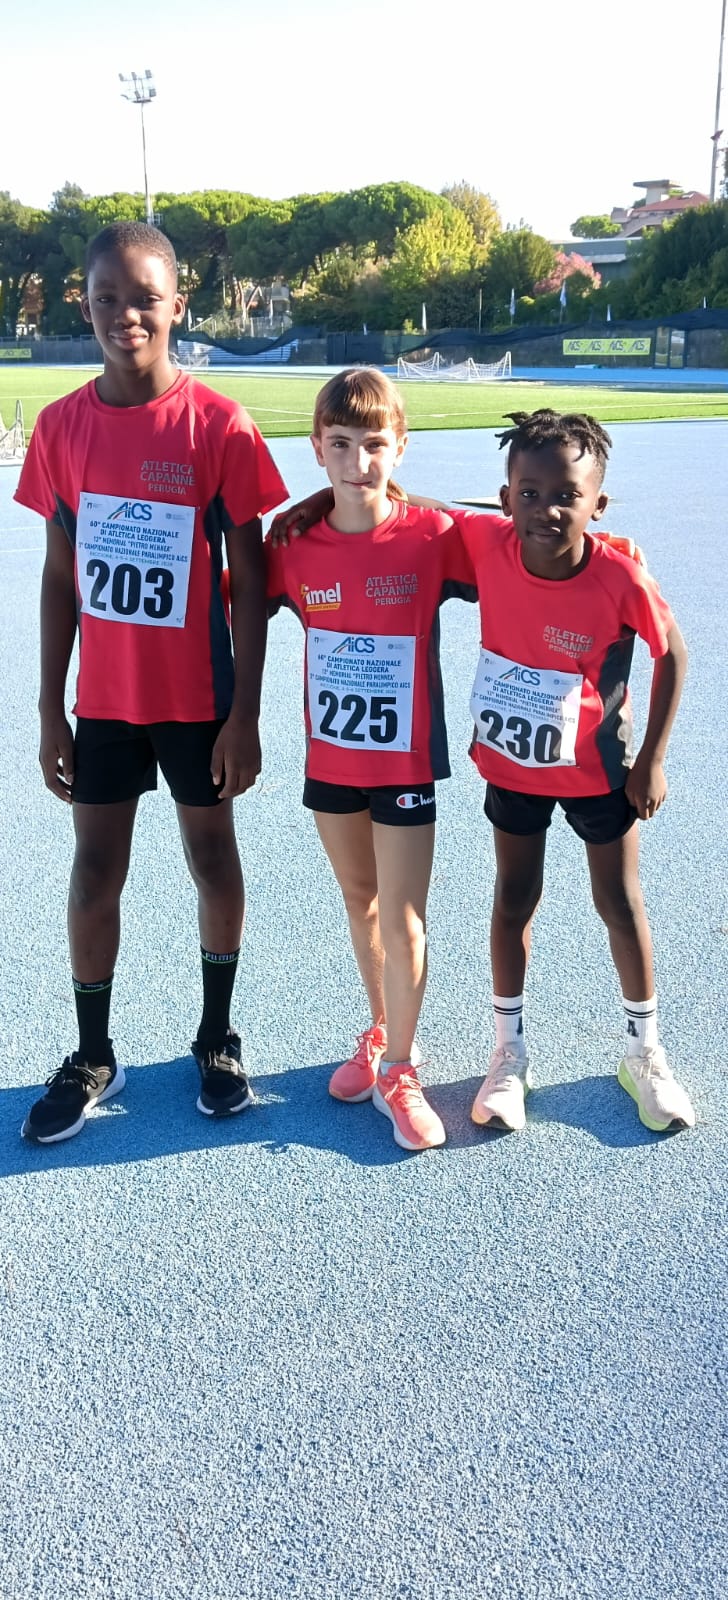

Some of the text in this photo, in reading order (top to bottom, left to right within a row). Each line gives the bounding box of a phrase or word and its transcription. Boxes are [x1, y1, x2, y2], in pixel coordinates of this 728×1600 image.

[140, 460, 194, 475] ATLETICA
[140, 471, 196, 486] CAPANNE
[147, 483, 187, 495] PERUGIA
[100, 528, 166, 544] DI ATLETICA LEGGERA
[102, 522, 141, 533] CAMPIONATO
[143, 527, 180, 539] NAZIONALE
[84, 542, 114, 553] CAMPIONATO
[115, 547, 140, 557] NAZIONALE
[103, 537, 126, 547] MEMORIAL
[366, 573, 418, 588] ATLETICA
[86, 558, 175, 619] 203
[365, 584, 419, 598] CAPANNE
[375, 596, 411, 606] PERUGIA
[543, 625, 593, 644] ATLETICA
[542, 633, 592, 653] CAPANNE
[327, 655, 365, 666] CAMPIONATO
[366, 659, 401, 667] NAZIONALE
[333, 663, 360, 672] ATLETICA
[329, 670, 351, 679] MEMORIAL
[340, 679, 365, 688] NAZIONALE
[493, 679, 531, 695] CAMPIONATO
[532, 690, 566, 702] NAZIONALE
[500, 687, 526, 699] ATLETICA
[527, 695, 554, 706] LEGGERA
[318, 690, 398, 744] 225
[480, 709, 563, 764] 230
[627, 1018, 640, 1037] A
